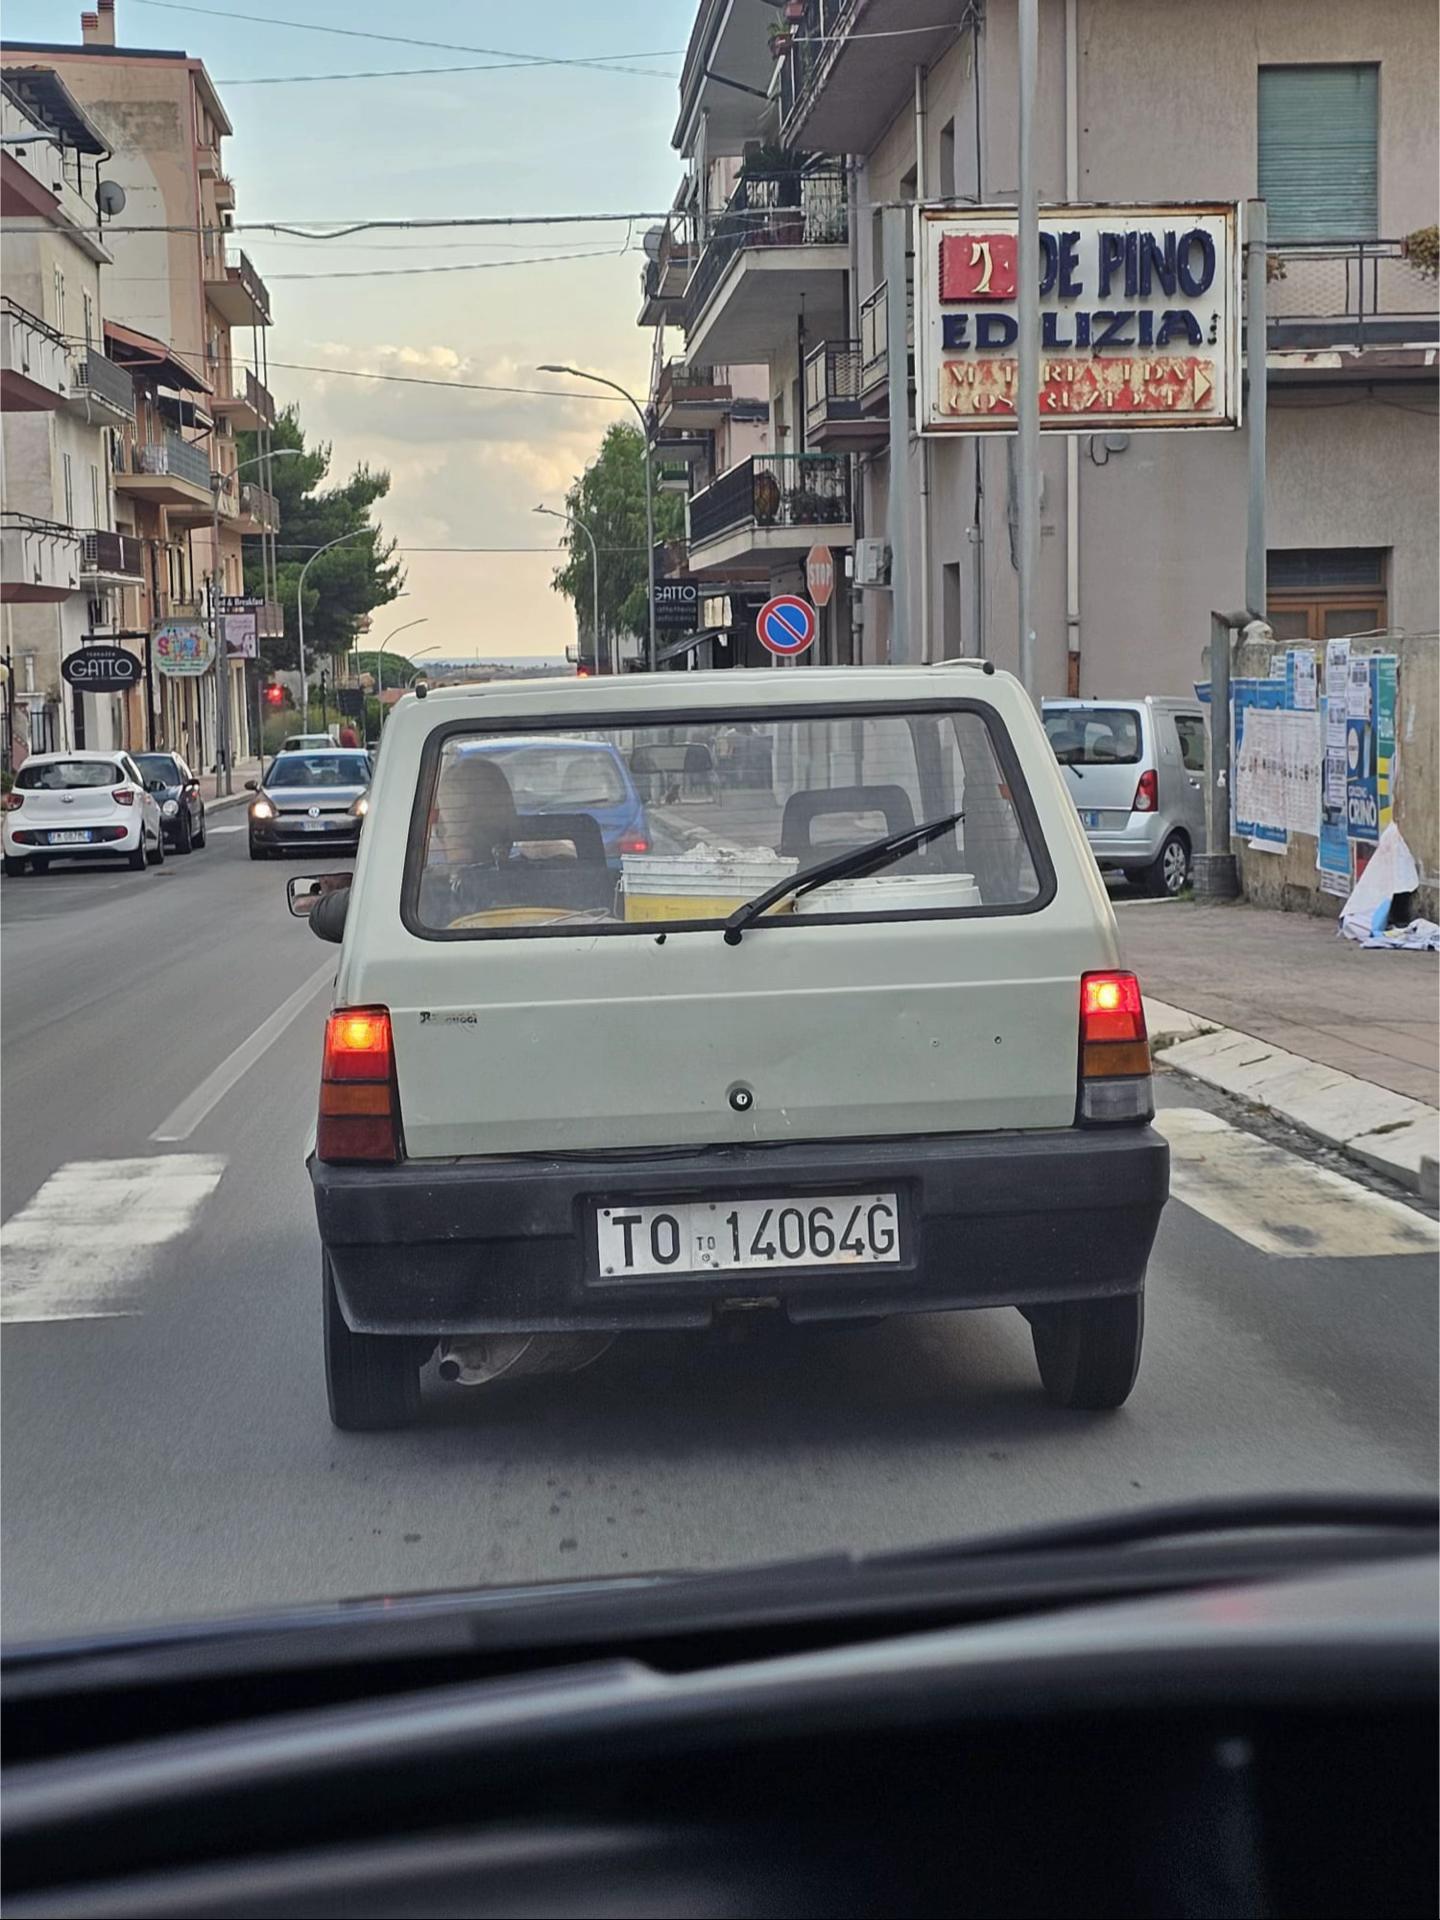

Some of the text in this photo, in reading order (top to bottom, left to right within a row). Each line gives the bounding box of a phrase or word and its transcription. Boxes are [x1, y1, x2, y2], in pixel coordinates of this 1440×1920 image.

[1098, 227, 1215, 298] PINO
[941, 309, 1203, 351] EDLIZIA
[809, 563, 833, 586] STOP
[69, 658, 133, 677] GATTO
[611, 1203, 895, 1268] TO TO 14064G
